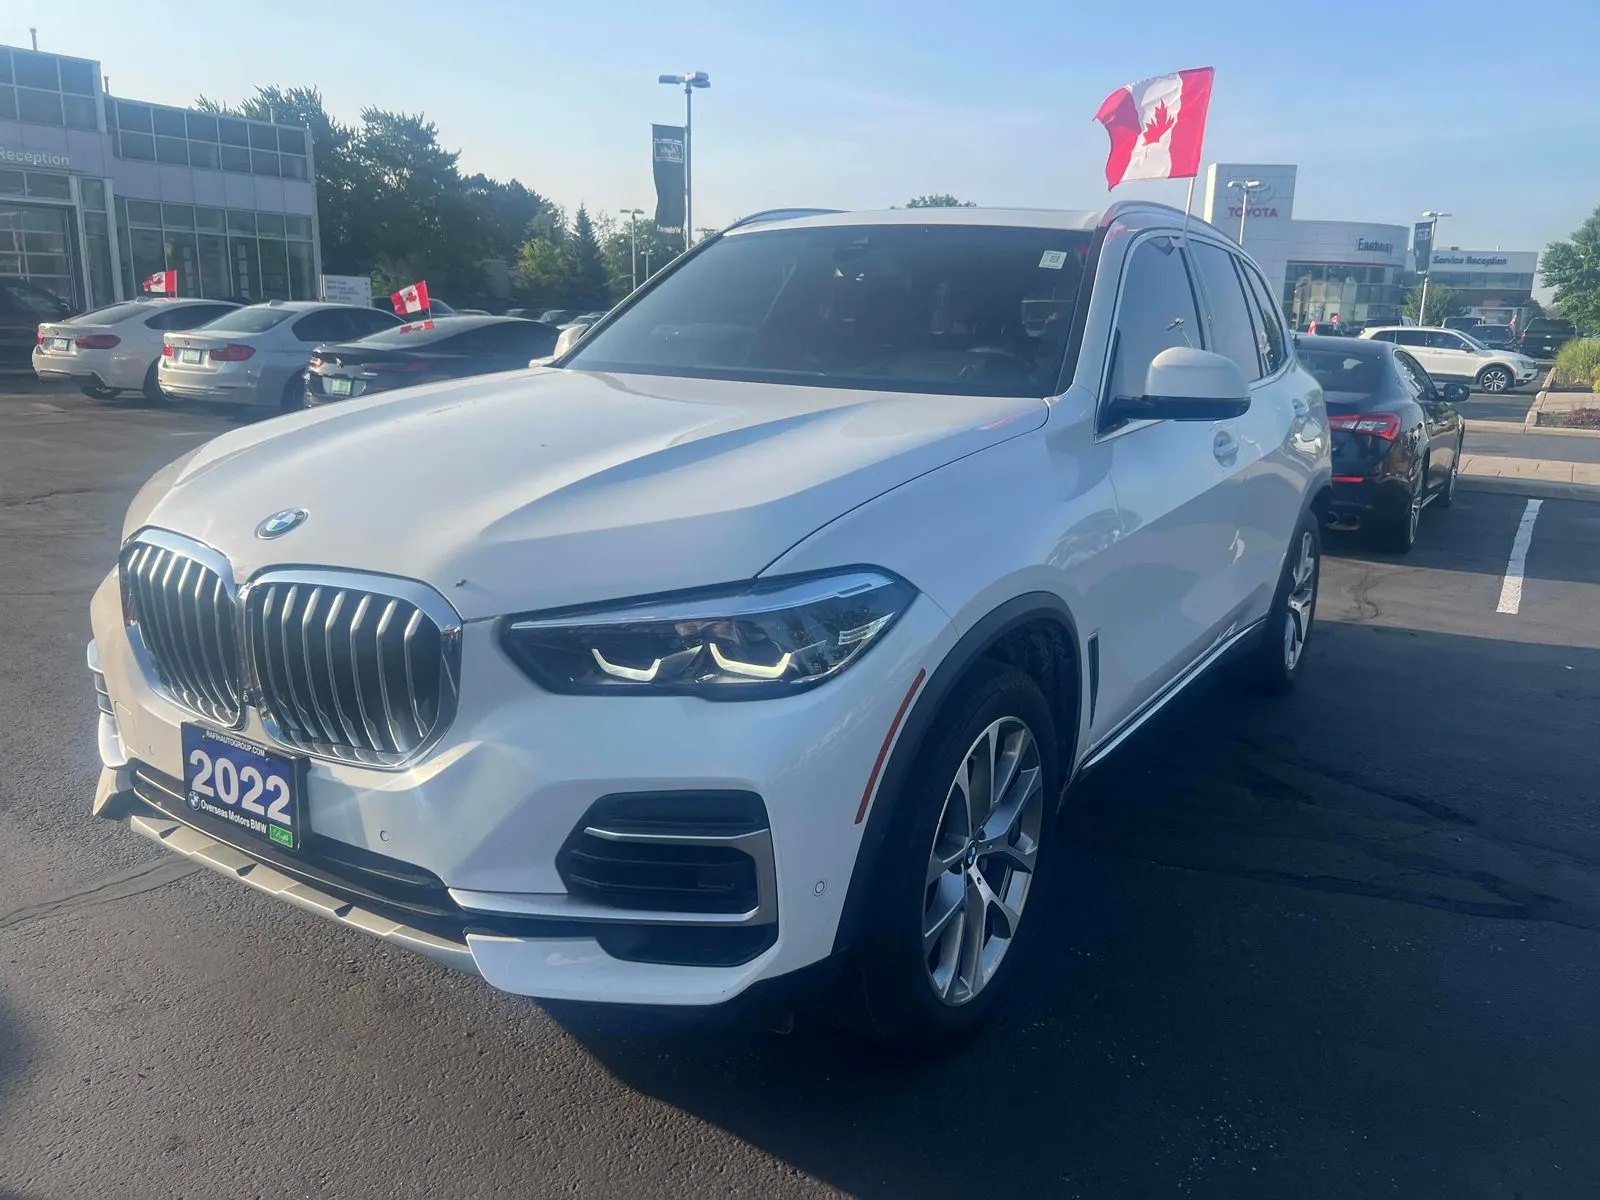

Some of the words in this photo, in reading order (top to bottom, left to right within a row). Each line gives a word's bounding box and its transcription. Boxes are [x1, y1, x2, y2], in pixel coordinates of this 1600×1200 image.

[0, 145, 70, 166] Reception
[1227, 206, 1278, 218] TOYOTA
[1433, 255, 1464, 265] Service
[1466, 256, 1507, 267] Reception
[190, 749, 291, 826] 2022
[200, 799, 229, 819] Overseas
[228, 810, 250, 828] Motors
[250, 818, 267, 834] BMW
